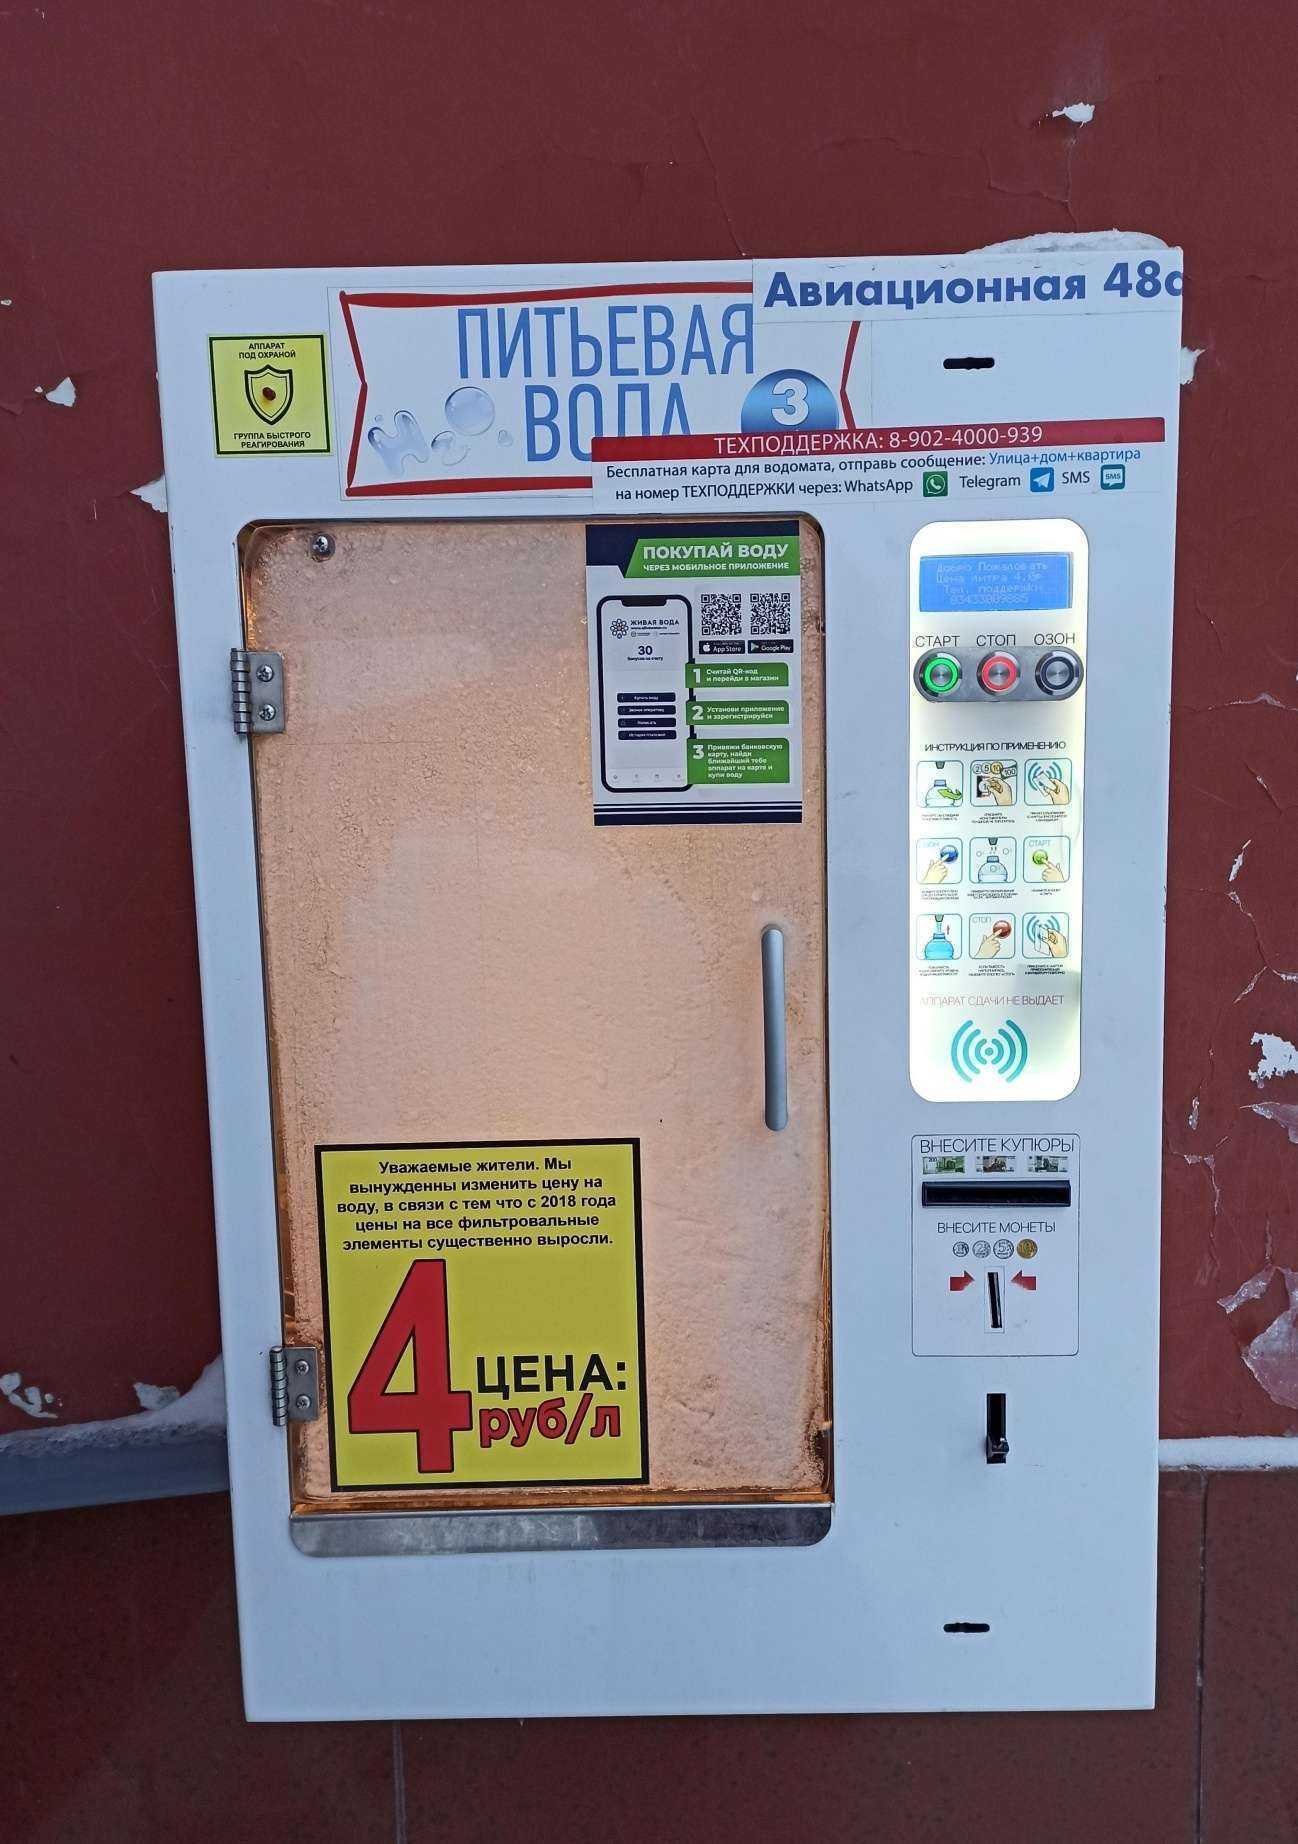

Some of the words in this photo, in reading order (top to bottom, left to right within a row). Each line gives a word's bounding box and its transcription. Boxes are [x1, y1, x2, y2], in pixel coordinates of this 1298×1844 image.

[764, 271, 1086, 310] Авиационная
[248, 342, 285, 350] АППАРАТ
[458, 303, 754, 379] ПИТЬЕВАЯ
[239, 352, 256, 360] ПОД
[258, 350, 296, 359] ОХРАНОЙ
[771, 378, 809, 426] 3
[234, 432, 264, 440] ГРУППА
[267, 431, 311, 439] БЫСТРОГО
[714, 432, 883, 456] ТЕХПОДДЕРЖКА:
[889, 426, 1043, 448] 8-902-4000-939
[607, 465, 687, 478] Бесплатная
[691, 465, 731, 478] карта
[734, 463, 760, 477] для
[764, 461, 835, 475] водомата,
[839, 459, 897, 473] отправь
[900, 455, 986, 470] сообщение:
[989, 448, 1141, 466] Улица+дом+квартира
[615, 489, 632, 500] на
[635, 487, 679, 502] номер
[682, 482, 795, 498] ТЕХПОДДЕРЖКИ
[798, 481, 842, 497] через:
[845, 479, 913, 494] WhatsApp
[960, 474, 1021, 489] Telegram
[1062, 471, 1090, 484] SMS
[643, 542, 733, 560] ПОКУПАЙ
[738, 543, 789, 560] ВОДУ
[643, 564, 671, 572] ЧЕРЕЗ
[672, 563, 727, 571] МОБИЛЬНОЕ
[728, 562, 789, 570] ПРИЛОЖЕНИЕ
[915, 635, 960, 647] СТАРТ
[976, 634, 1016, 646] СТОП
[1034, 633, 1075, 646] ОЗОН
[638, 645, 653, 655] 30
[693, 668, 700, 683] 1
[692, 706, 704, 720] 2
[693, 745, 704, 760] 3
[925, 742, 984, 752] ИНСТРУКЦИЯ
[986, 742, 1000, 751] ПО
[1001, 741, 1066, 751] ПРИМЕНЕНИЮ
[968, 995, 1004, 1006] СДАЧИ
[1007, 995, 1020, 1005] НЕ
[1022, 994, 1064, 1006] ВЫДАЕТ
[920, 1138, 997, 1153] ВНЕСИТЕ
[1001, 1137, 1075, 1152] КУПЮРЫ
[379, 1160, 472, 1175] Уважаемые
[476, 1159, 539, 1173] жители.
[544, 1157, 572, 1170] Мы
[350, 1181, 456, 1195] вынужденны
[461, 1179, 537, 1191] изменить
[542, 1179, 579, 1193] цену
[584, 1178, 603, 1188] на
[337, 1202, 379, 1216] воду,
[384, 1202, 393, 1212] в
[399, 1200, 444, 1211] связи
[450, 1200, 458, 1210] с
[462, 1199, 491, 1210] тем
[496, 1198, 523, 1209] что
[527, 1198, 536, 1208] с
[540, 1195, 576, 1208] 2018
[581, 1196, 616, 1208] года
[355, 1220, 397, 1233] цены
[403, 1220, 421, 1230] на
[427, 1219, 453, 1230] все
[458, 1213, 599, 1232] фильтровальные
[938, 1222, 996, 1234] ВНЕСИТЕ
[1000, 1221, 1056, 1233] МОНЕТЫ
[343, 1239, 423, 1251] элементы
[427, 1236, 532, 1252] существенно
[537, 1234, 613, 1247] выросли.
[347, 1258, 473, 1473] 4
[476, 1354, 627, 1400] ЦЕНА:
[479, 1393, 621, 1448] руб/л
